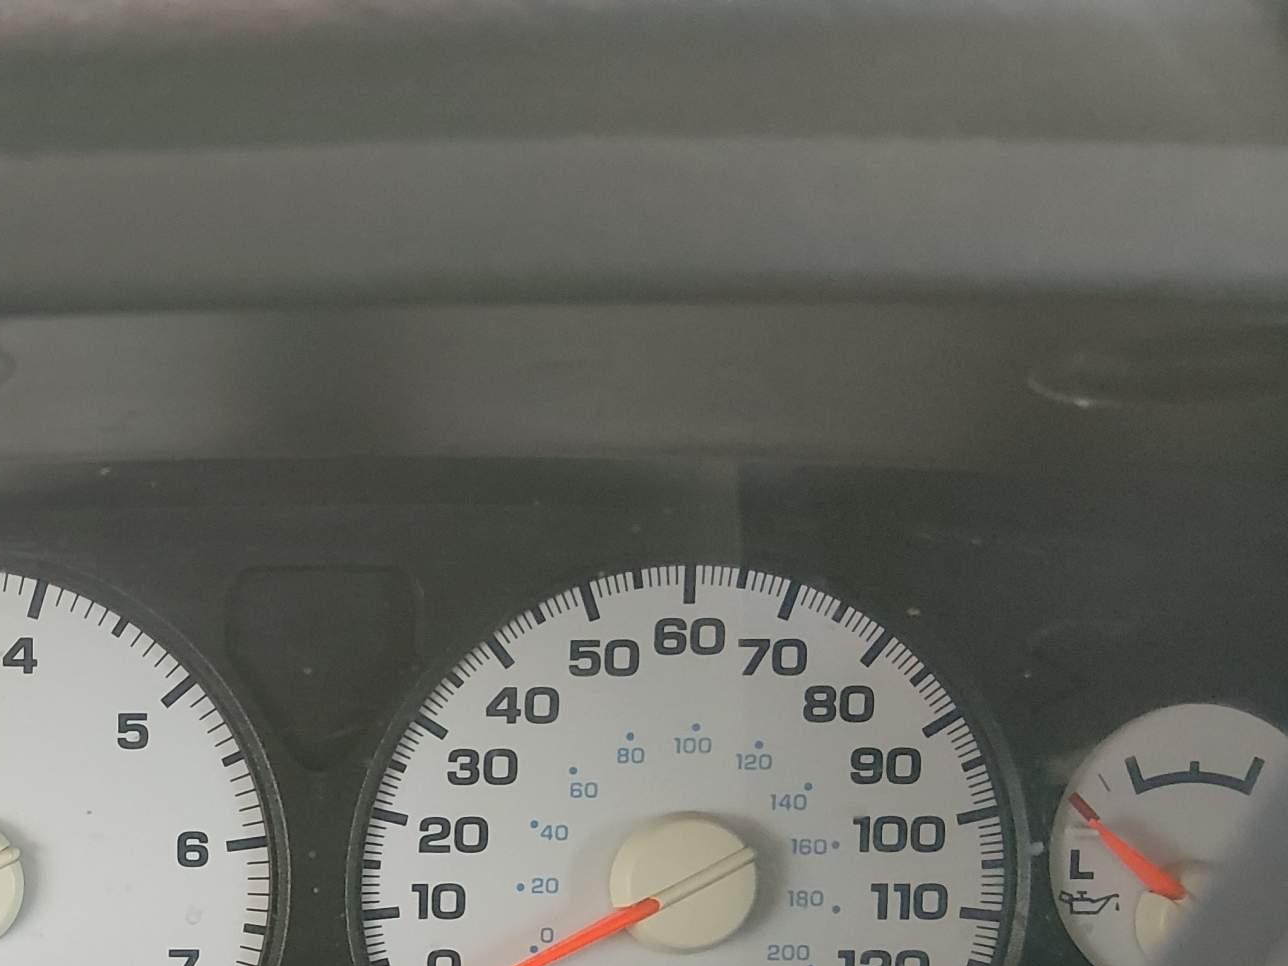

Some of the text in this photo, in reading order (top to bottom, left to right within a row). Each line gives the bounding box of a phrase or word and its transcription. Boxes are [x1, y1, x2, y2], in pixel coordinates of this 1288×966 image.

[653, 618, 726, 656] 60
[3, 638, 38, 674] 4
[569, 639, 640, 676] 50
[738, 639, 807, 675] 70
[486, 687, 559, 724] 40
[803, 685, 874, 723] 80
[117, 713, 149, 749] 5
[674, 737, 712, 754] 100
[447, 749, 518, 785] 30
[616, 747, 645, 764] 80
[736, 753, 773, 771] 120
[850, 748, 921, 784] 90
[569, 782, 598, 799] 60
[770, 794, 807, 811] 140
[177, 832, 209, 868] 6
[419, 817, 489, 853] 20
[540, 824, 569, 842] 40
[791, 838, 828, 856] 160
[853, 816, 946, 852] 100
[1070, 849, 1094, 879] L
[412, 883, 466, 920] 10
[531, 877, 559, 895] 20
[787, 890, 824, 908] 180
[871, 883, 948, 920] 110
[540, 928, 554, 944] 0
[767, 945, 810, 962] 200
